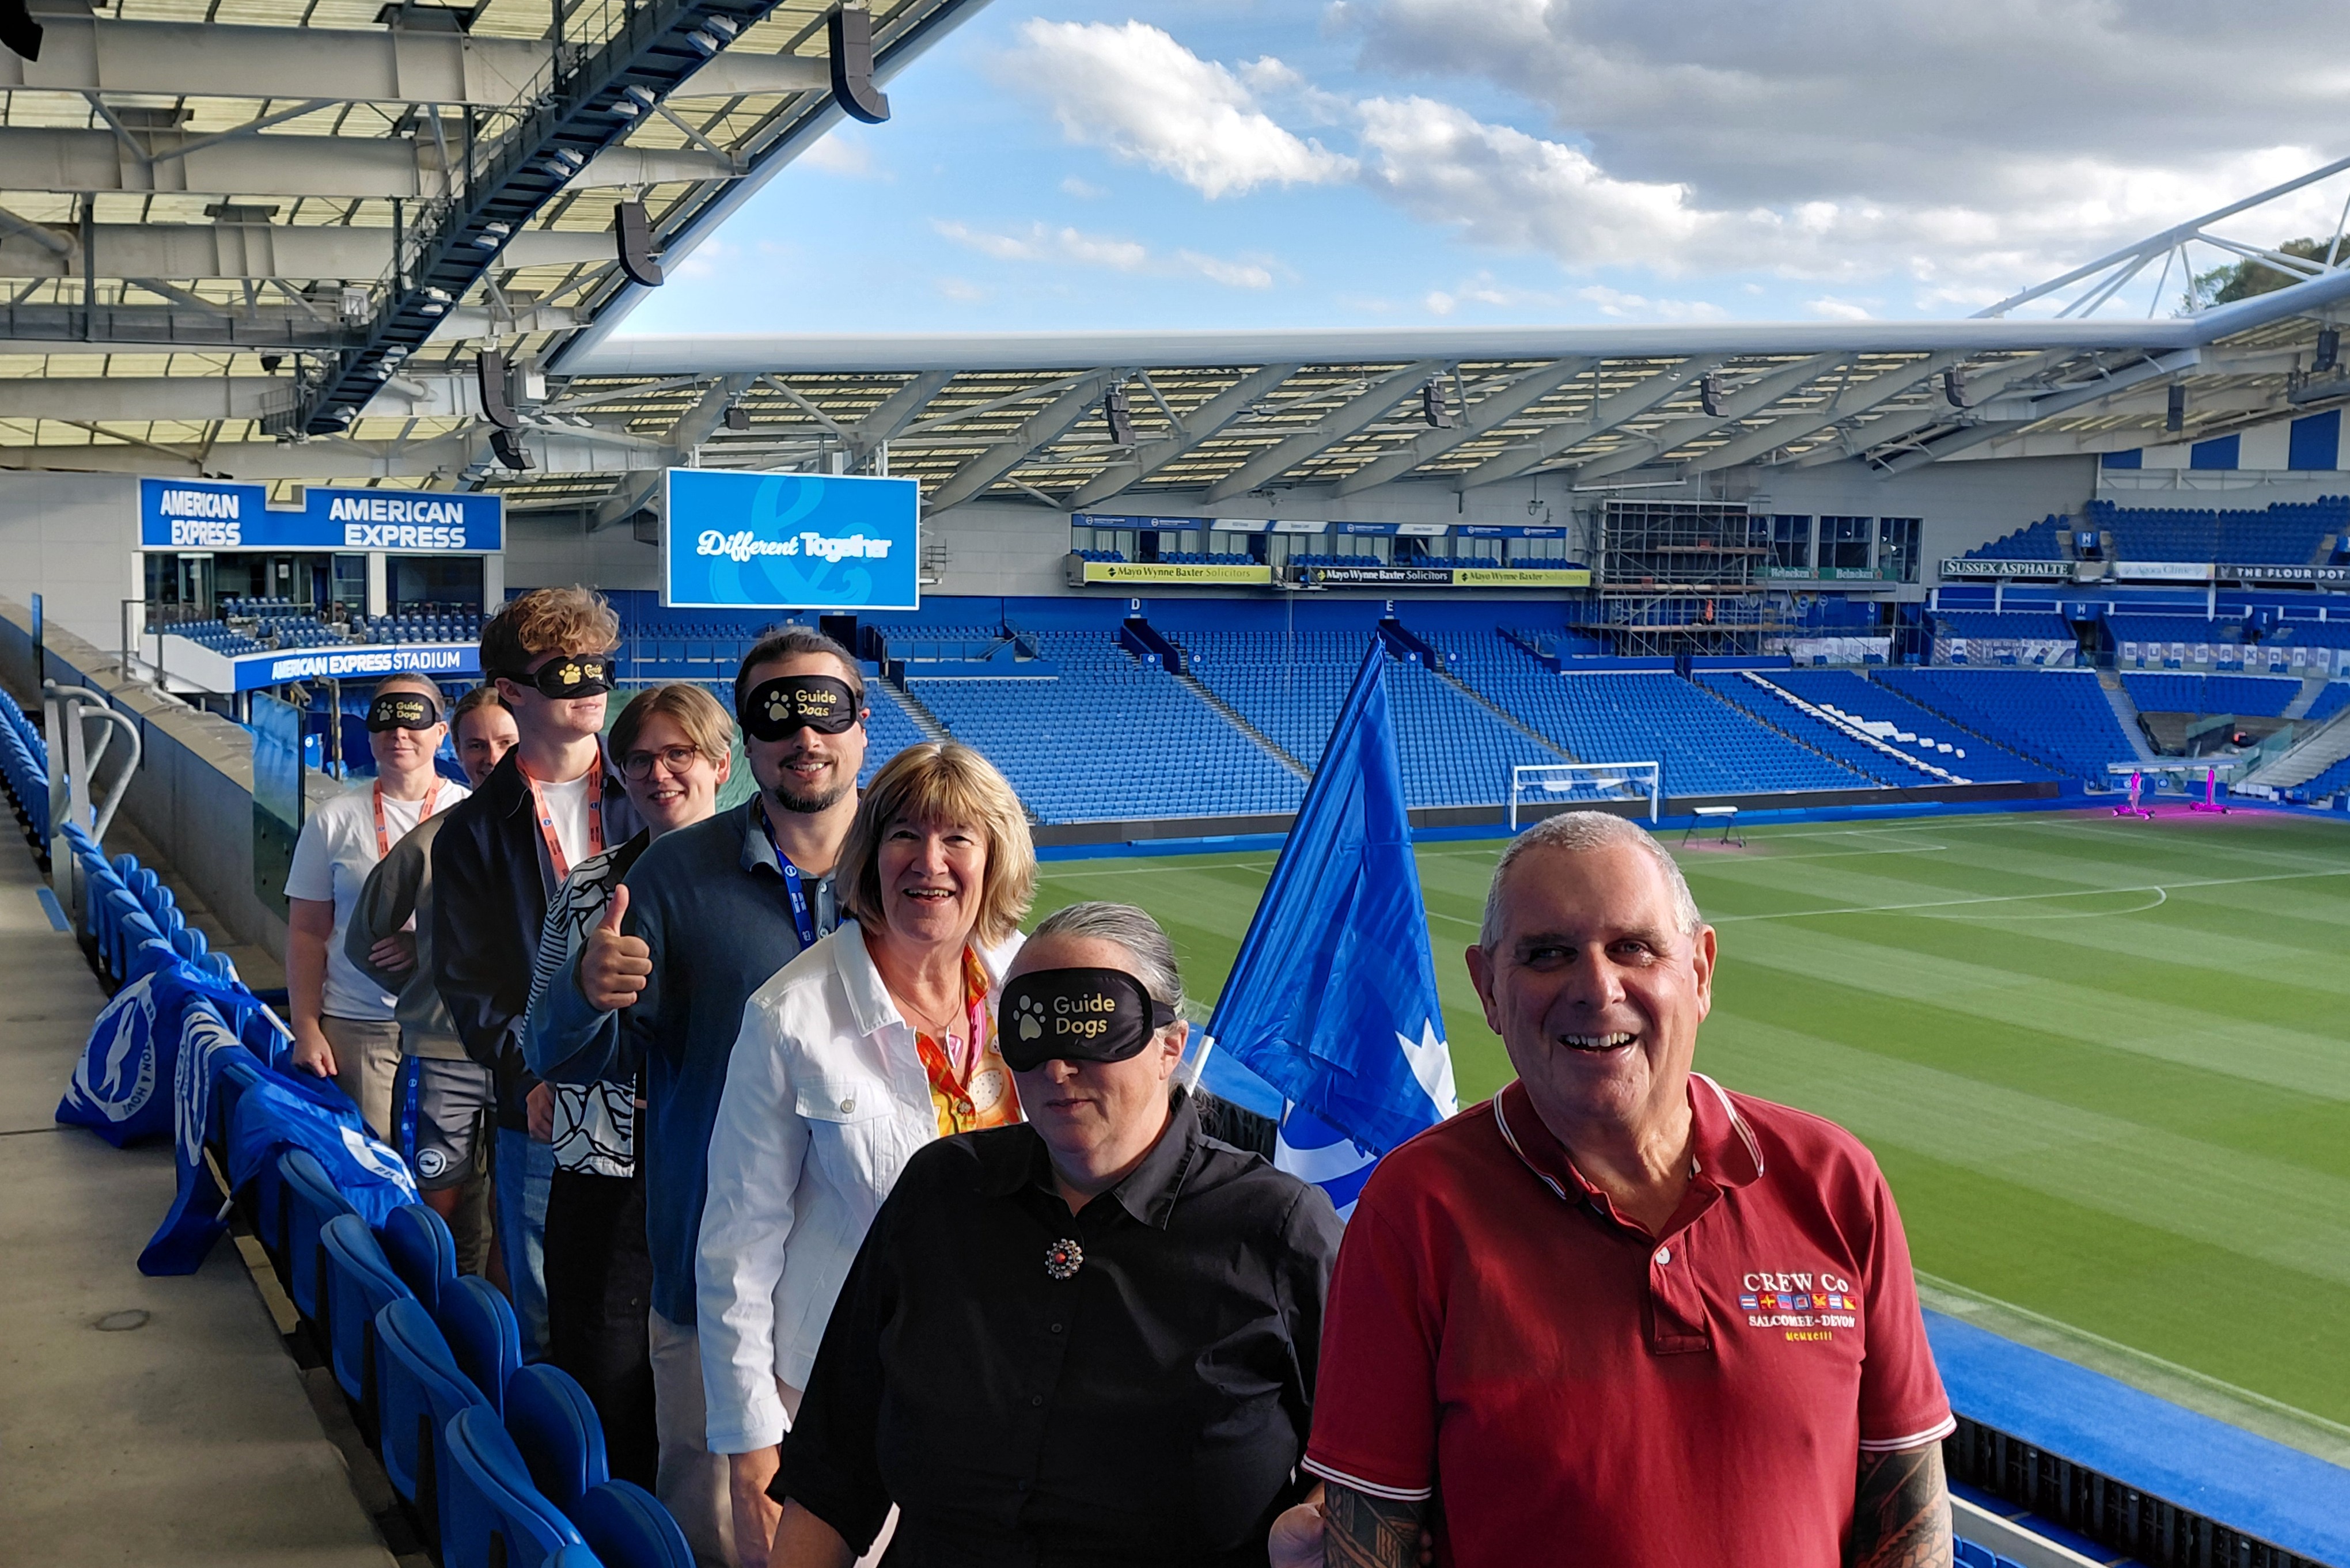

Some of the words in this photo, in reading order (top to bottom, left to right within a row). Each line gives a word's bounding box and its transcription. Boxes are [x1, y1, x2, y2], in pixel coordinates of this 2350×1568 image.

[160, 490, 239, 518] AMERICAN
[329, 498, 464, 524] AMERICAN
[172, 520, 241, 546] EXPRESS
[345, 523, 466, 548] EXPRESS
[696, 529, 799, 563] Different
[799, 531, 892, 563] Together
[1117, 567, 1142, 577] Mayo
[1143, 567, 1174, 578] Wynne
[1176, 567, 1204, 577] Baxter
[1206, 568, 1250, 578] Solicitors
[1326, 568, 1350, 581] Mayo
[1350, 568, 1378, 582] Wynne
[1379, 569, 1405, 580] Baxter
[1406, 570, 1448, 581] Solicitors
[1836, 569, 1874, 579] Heineken
[1947, 560, 1997, 573] SUSSEX
[2000, 561, 2068, 575] ASPHALTE
[2237, 568, 2262, 578] THE
[2267, 568, 2313, 579] FLOUR
[2317, 570, 2346, 580] POT
[1469, 571, 1490, 582] Mayo
[1491, 571, 1516, 582] Wynne
[1517, 572, 1543, 581] Baxter
[1131, 598, 1140, 610] D
[1386, 600, 1394, 612] E
[271, 658, 328, 681] AMERICAN
[329, 652, 392, 674] EXPRESS
[393, 651, 460, 671] STADIUM
[795, 689, 837, 704] Guide
[396, 701, 424, 712] Guide
[396, 711, 421, 720] Dogs
[1053, 993, 1116, 1014] Guide
[1056, 1017, 1108, 1039] Dogs
[1743, 1271, 1813, 1292] CREW
[1821, 1273, 1849, 1293] Co
